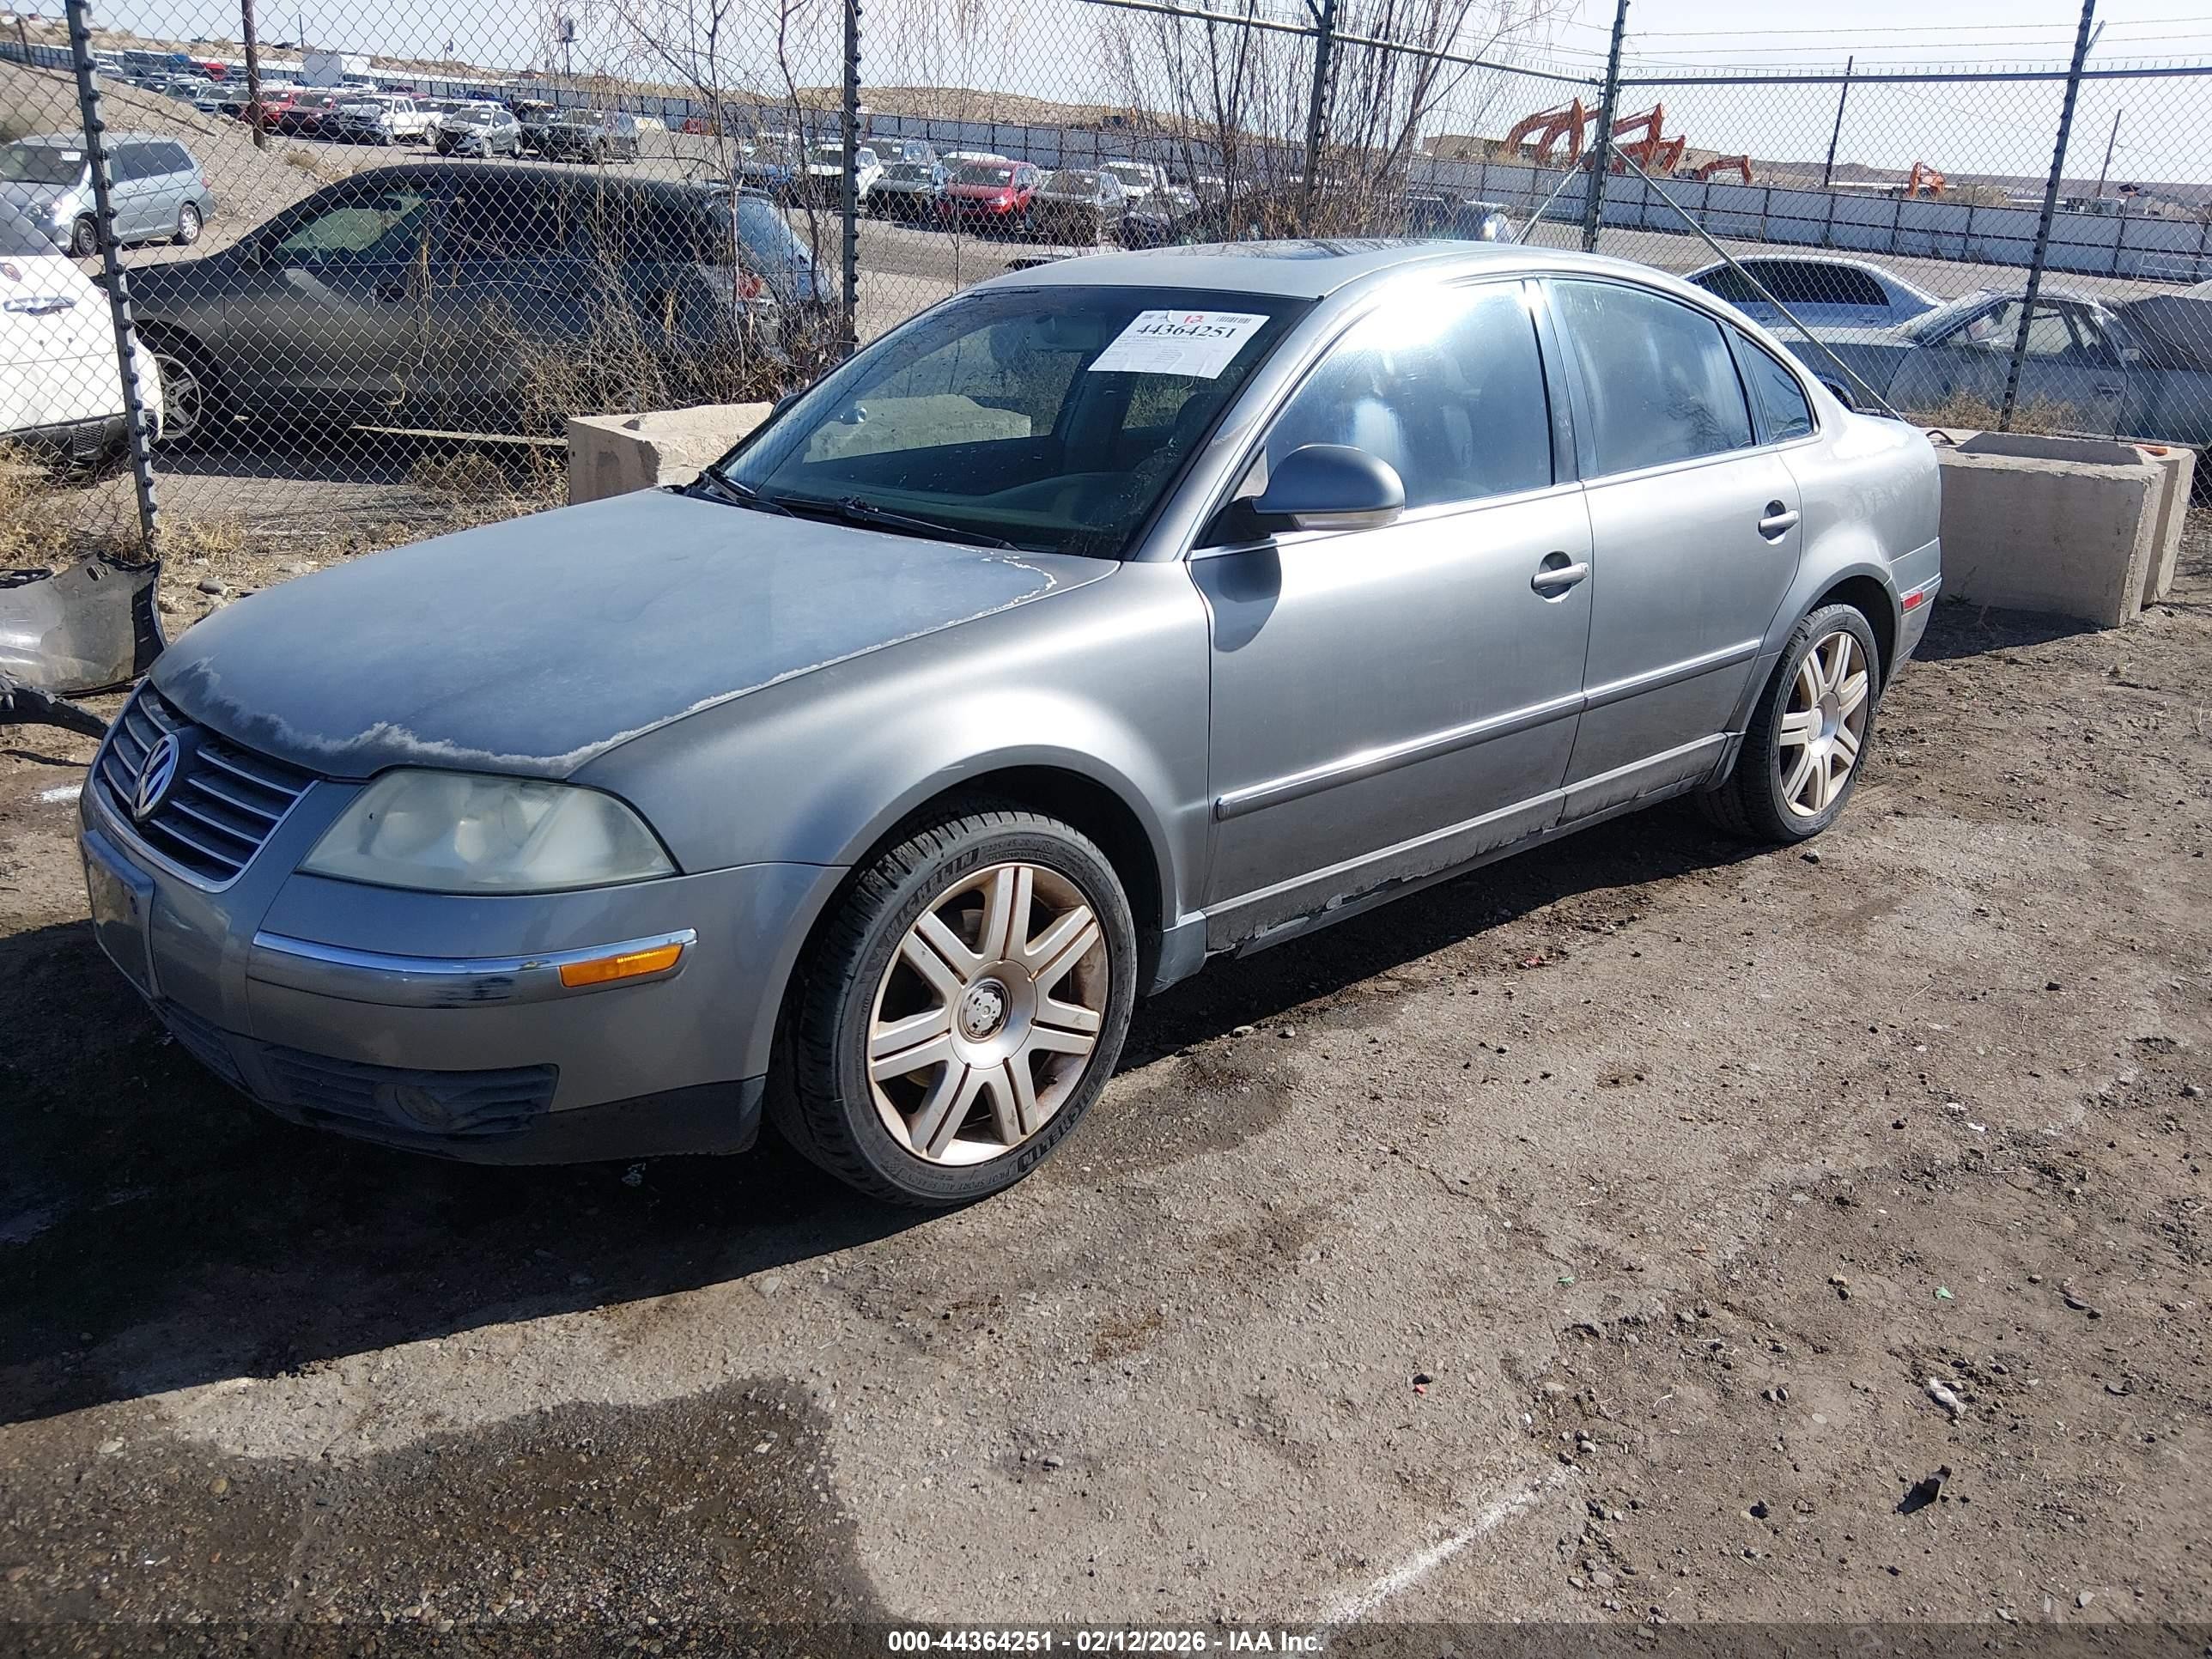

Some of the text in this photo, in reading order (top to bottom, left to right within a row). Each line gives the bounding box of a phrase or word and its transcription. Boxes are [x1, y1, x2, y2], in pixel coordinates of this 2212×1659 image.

[1136, 323, 1237, 338] 44364251
[884, 849, 975, 944] MICHELIN
[1022, 1081, 1097, 1167] MICHELIN
[988, 1168, 1011, 1184] PILOT
[958, 1179, 985, 1190] SPORT
